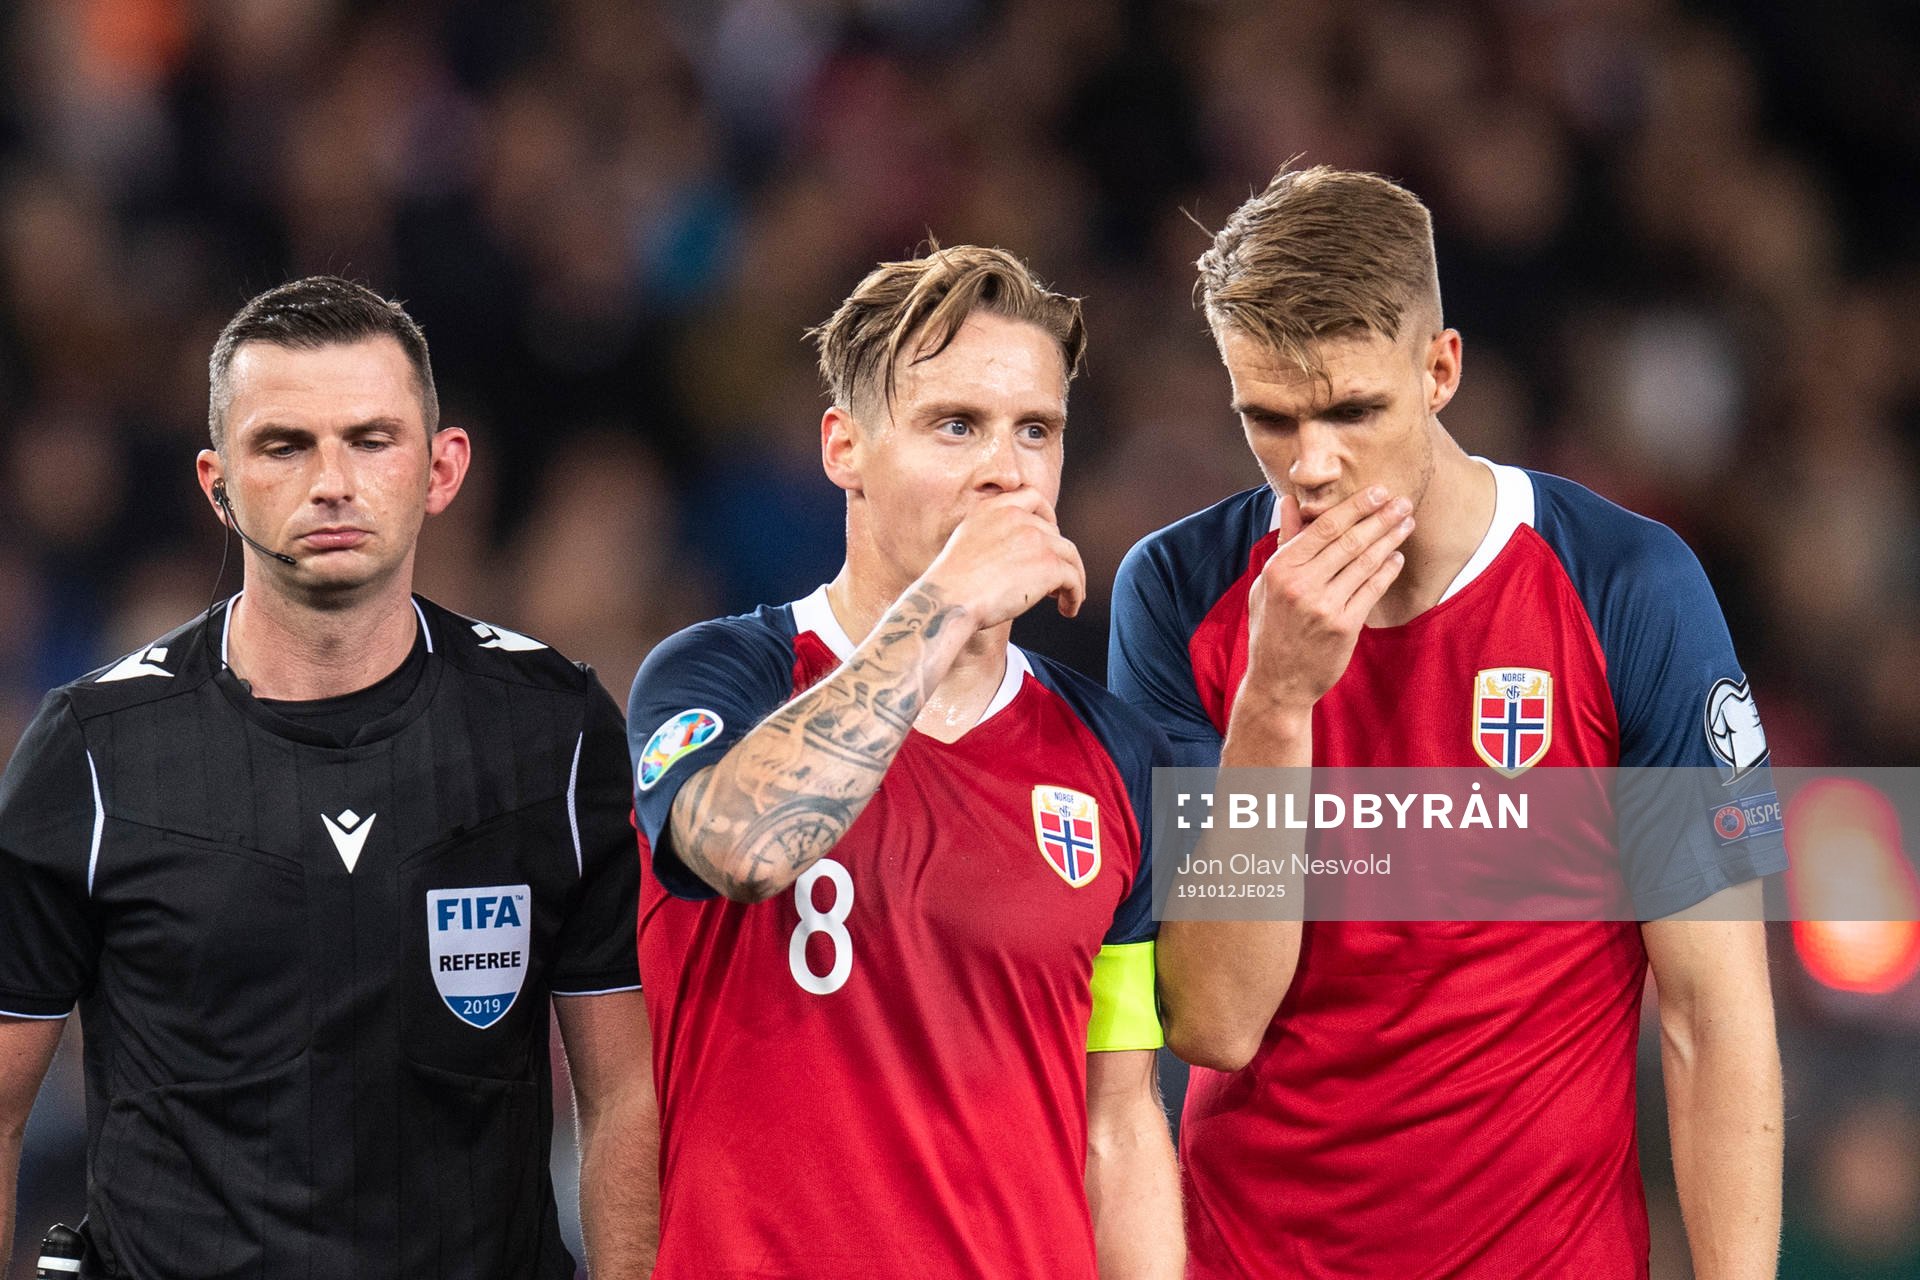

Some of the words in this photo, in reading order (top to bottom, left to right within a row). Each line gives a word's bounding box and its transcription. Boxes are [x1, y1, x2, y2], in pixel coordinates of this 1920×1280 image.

[1502, 673, 1526, 682] NORGE
[1054, 791, 1074, 804] NORGE
[437, 896, 521, 931] FIFA
[788, 858, 855, 996] 8
[439, 951, 521, 972] REFEREE
[463, 998, 501, 1015] 2019
